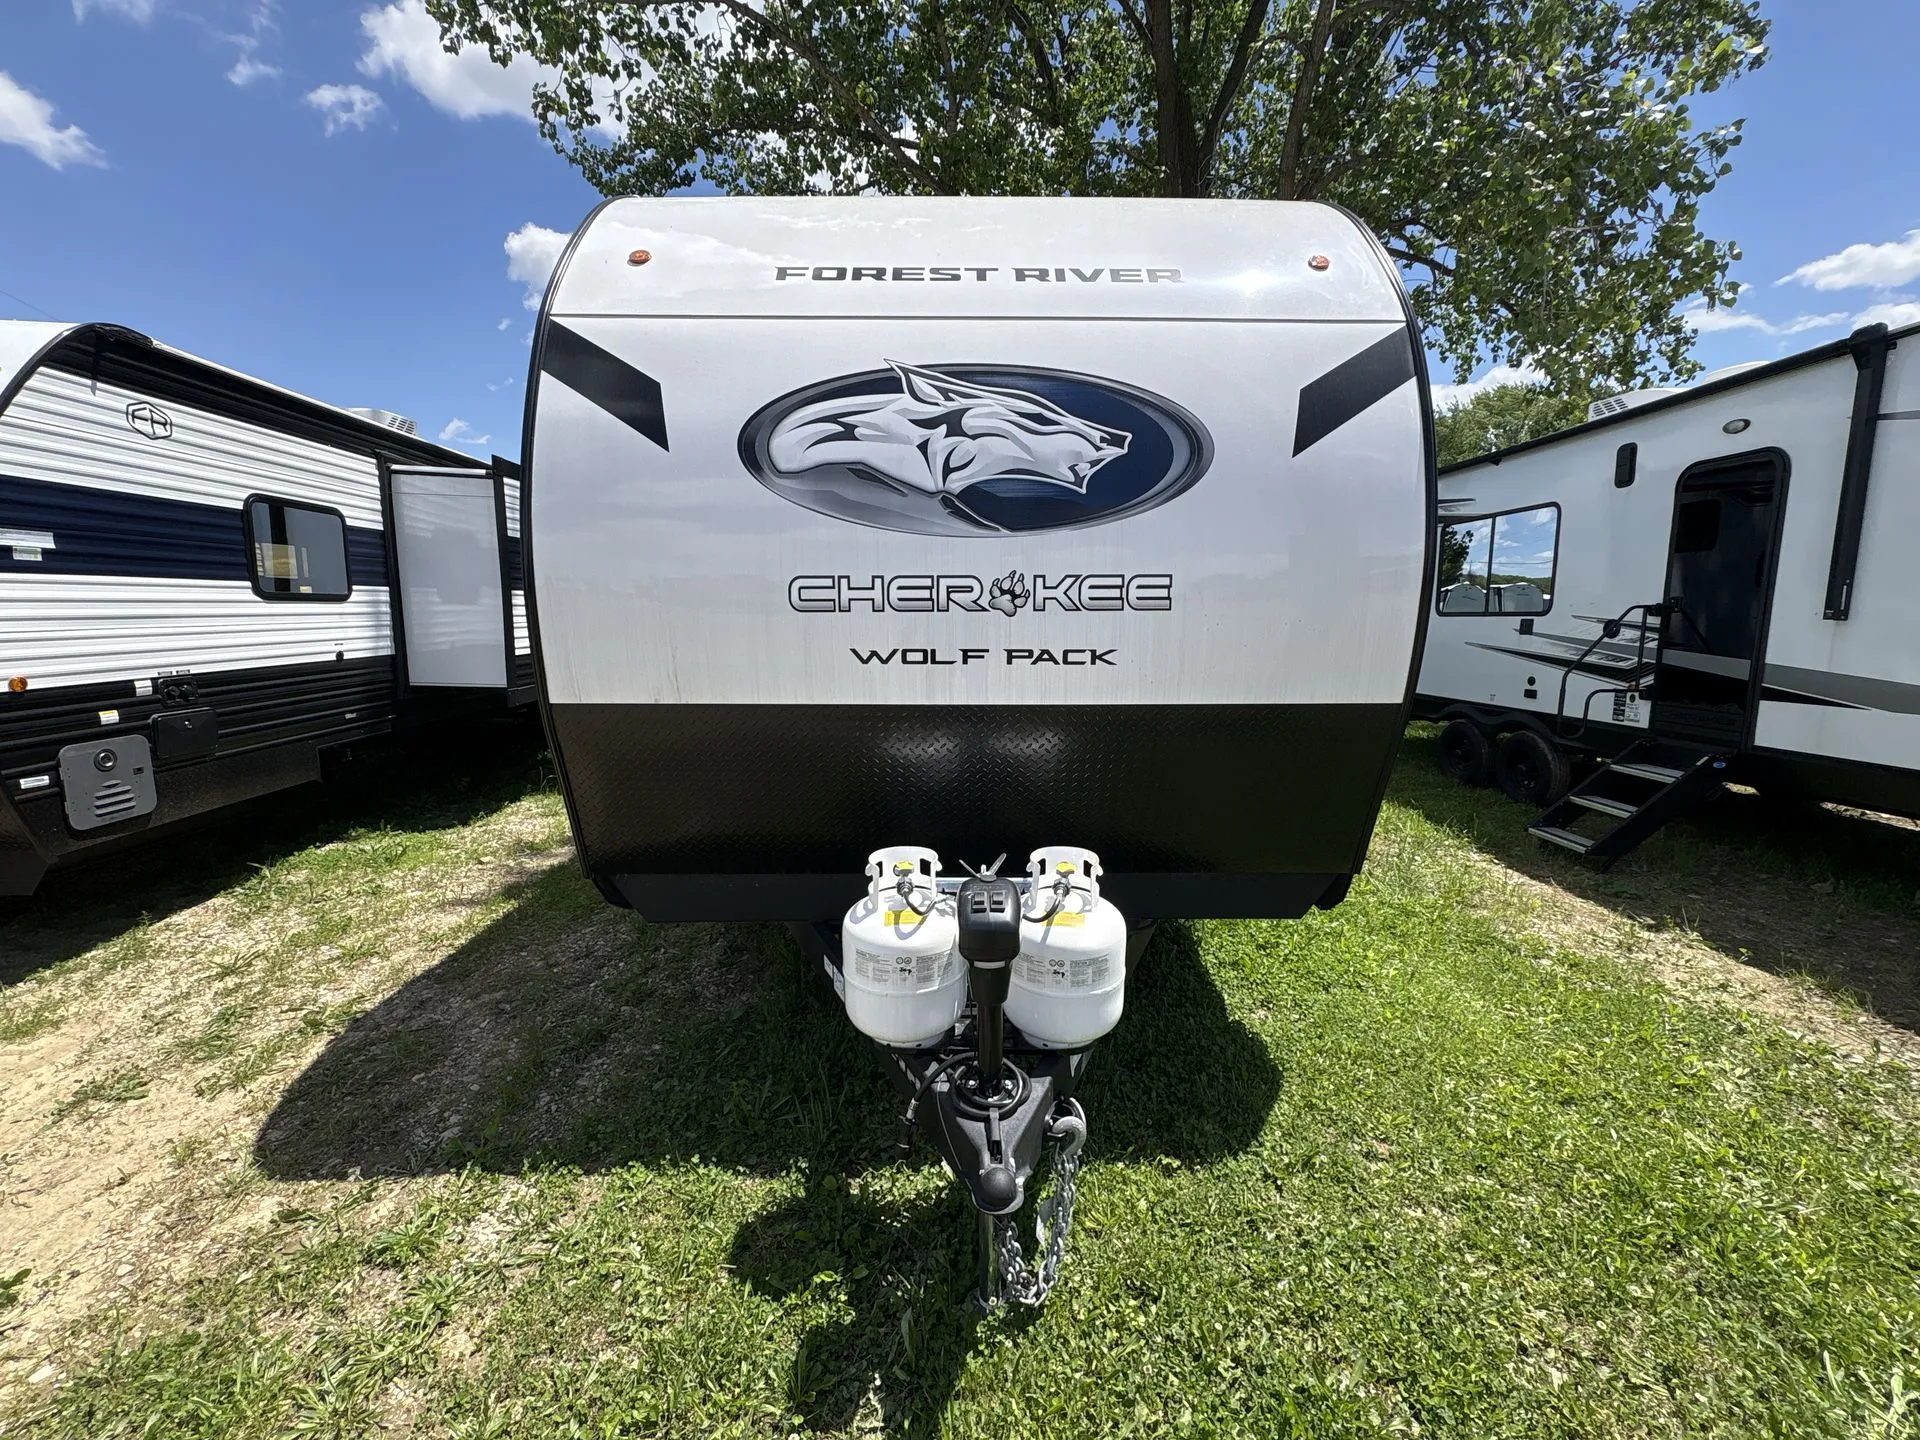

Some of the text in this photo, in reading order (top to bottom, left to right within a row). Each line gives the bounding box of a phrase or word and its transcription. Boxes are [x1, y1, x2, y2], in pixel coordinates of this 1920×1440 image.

[775, 266, 1184, 283] FOREST RIVER
[849, 647, 1119, 666] WOLF PACK
